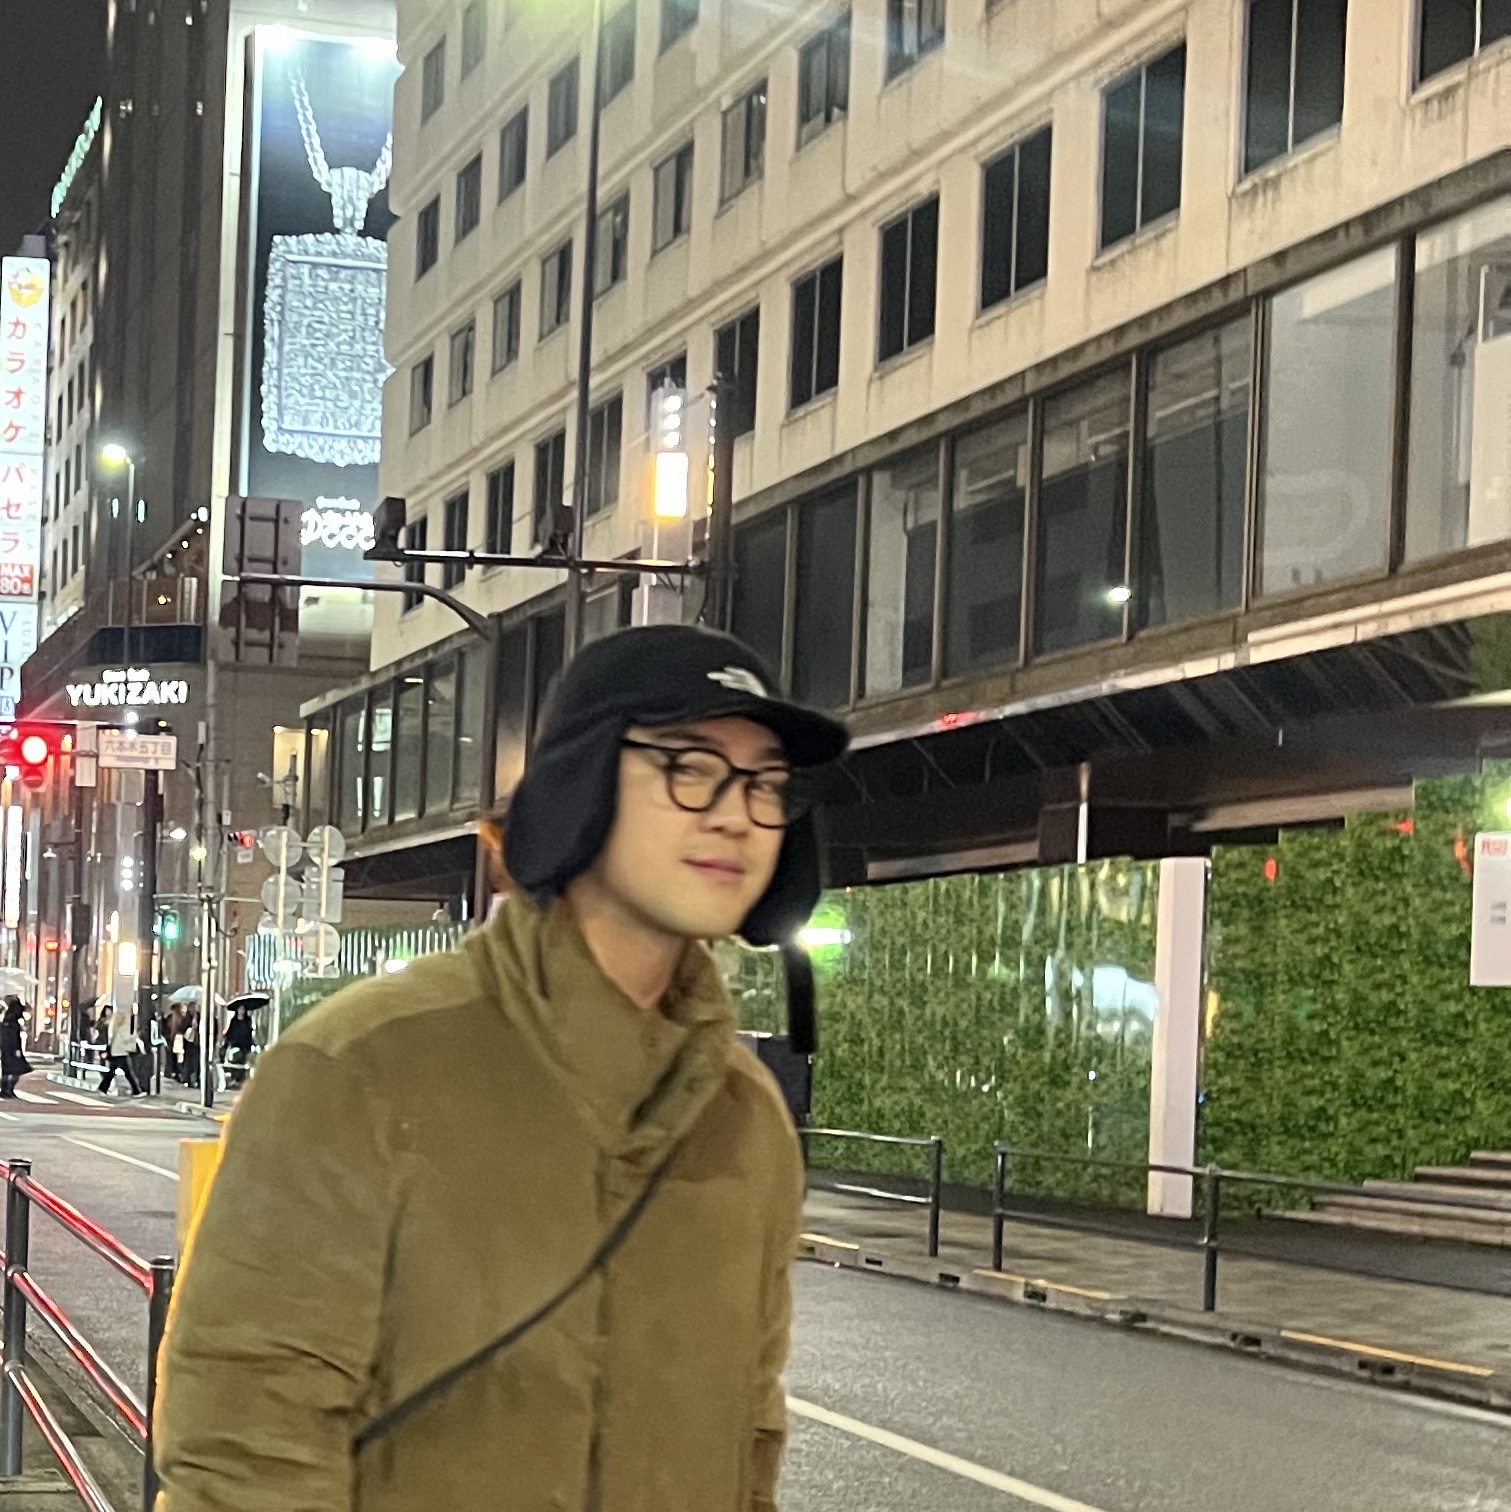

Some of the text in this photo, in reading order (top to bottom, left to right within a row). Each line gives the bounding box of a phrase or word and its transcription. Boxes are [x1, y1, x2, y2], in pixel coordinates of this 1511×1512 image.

[0, 316, 27, 554] カラオケ パセラ
[1, 564, 32, 578] MAX
[66, 680, 188, 706] YUKIZAKI
[105, 740, 172, 756] 六本木五丁目
